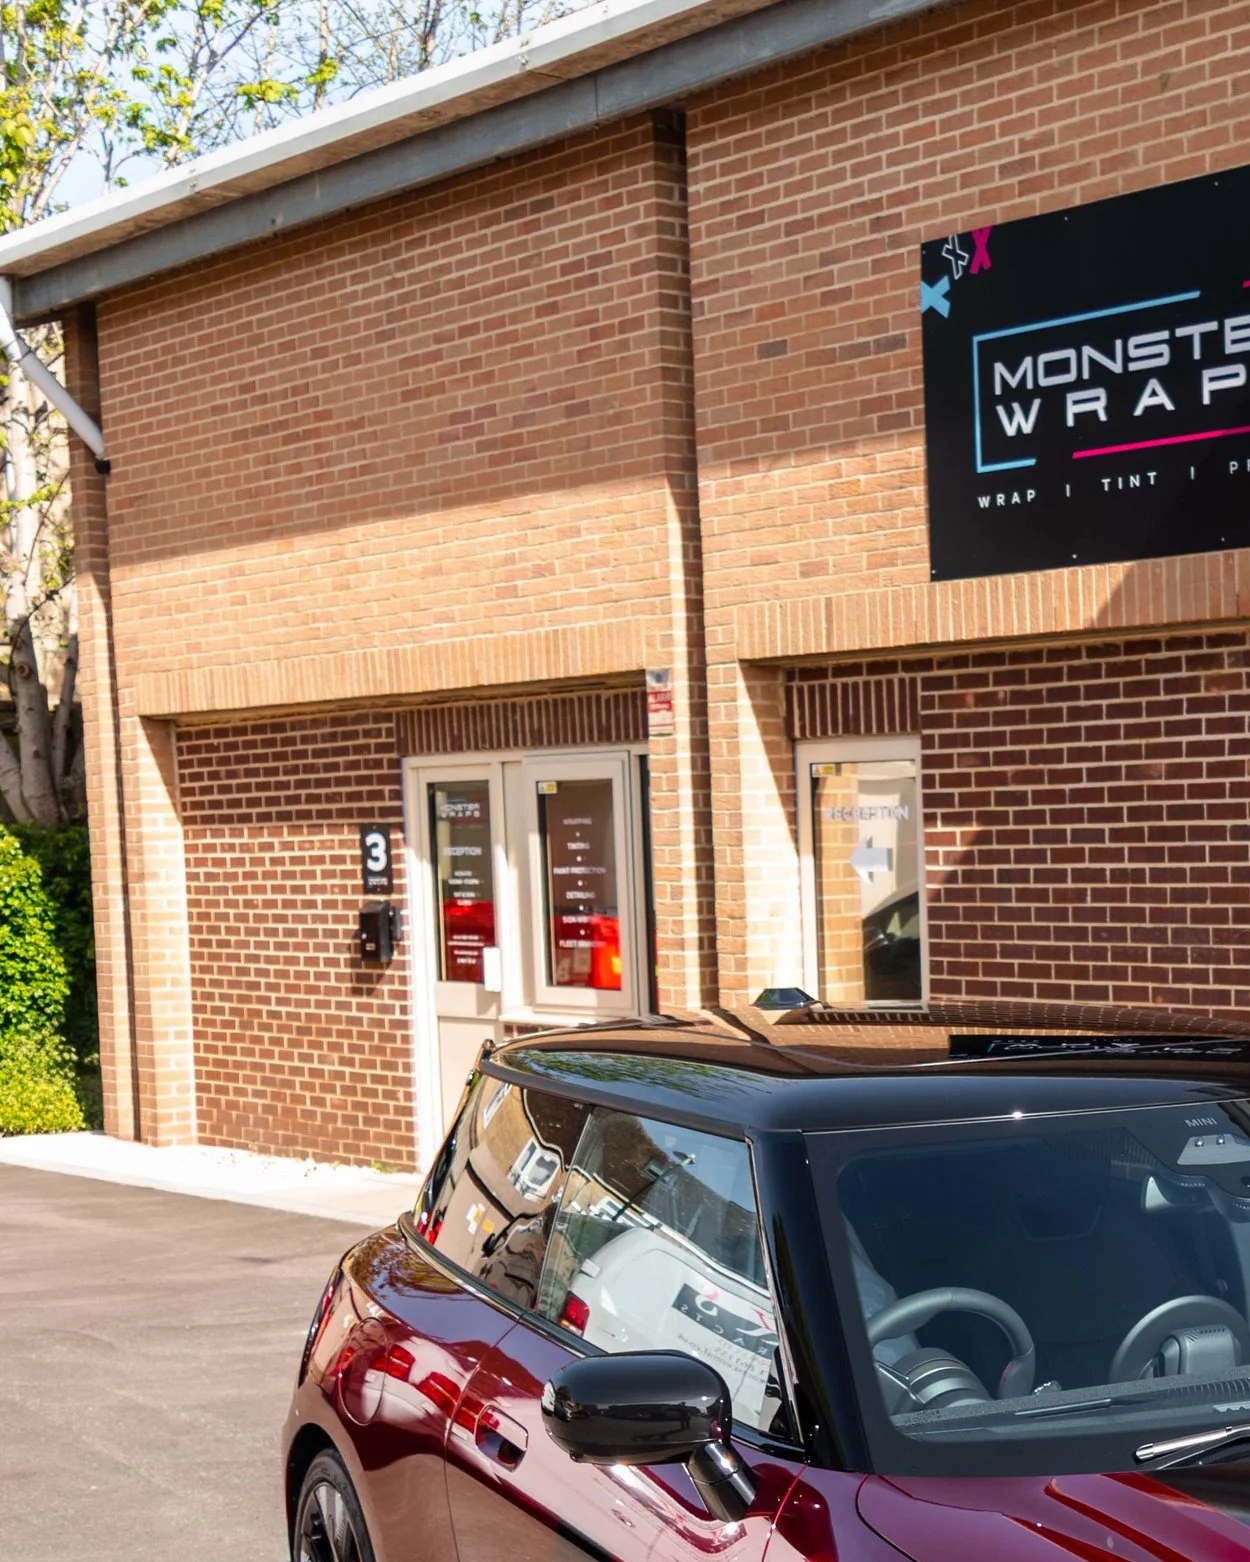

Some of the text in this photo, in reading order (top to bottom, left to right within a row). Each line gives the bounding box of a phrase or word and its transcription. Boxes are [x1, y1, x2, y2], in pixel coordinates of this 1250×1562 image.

[978, 488, 1037, 509] WRAP
[1101, 471, 1158, 492] TINT
[365, 832, 388, 872] 3
[1184, 1117, 1218, 1128] MINI
